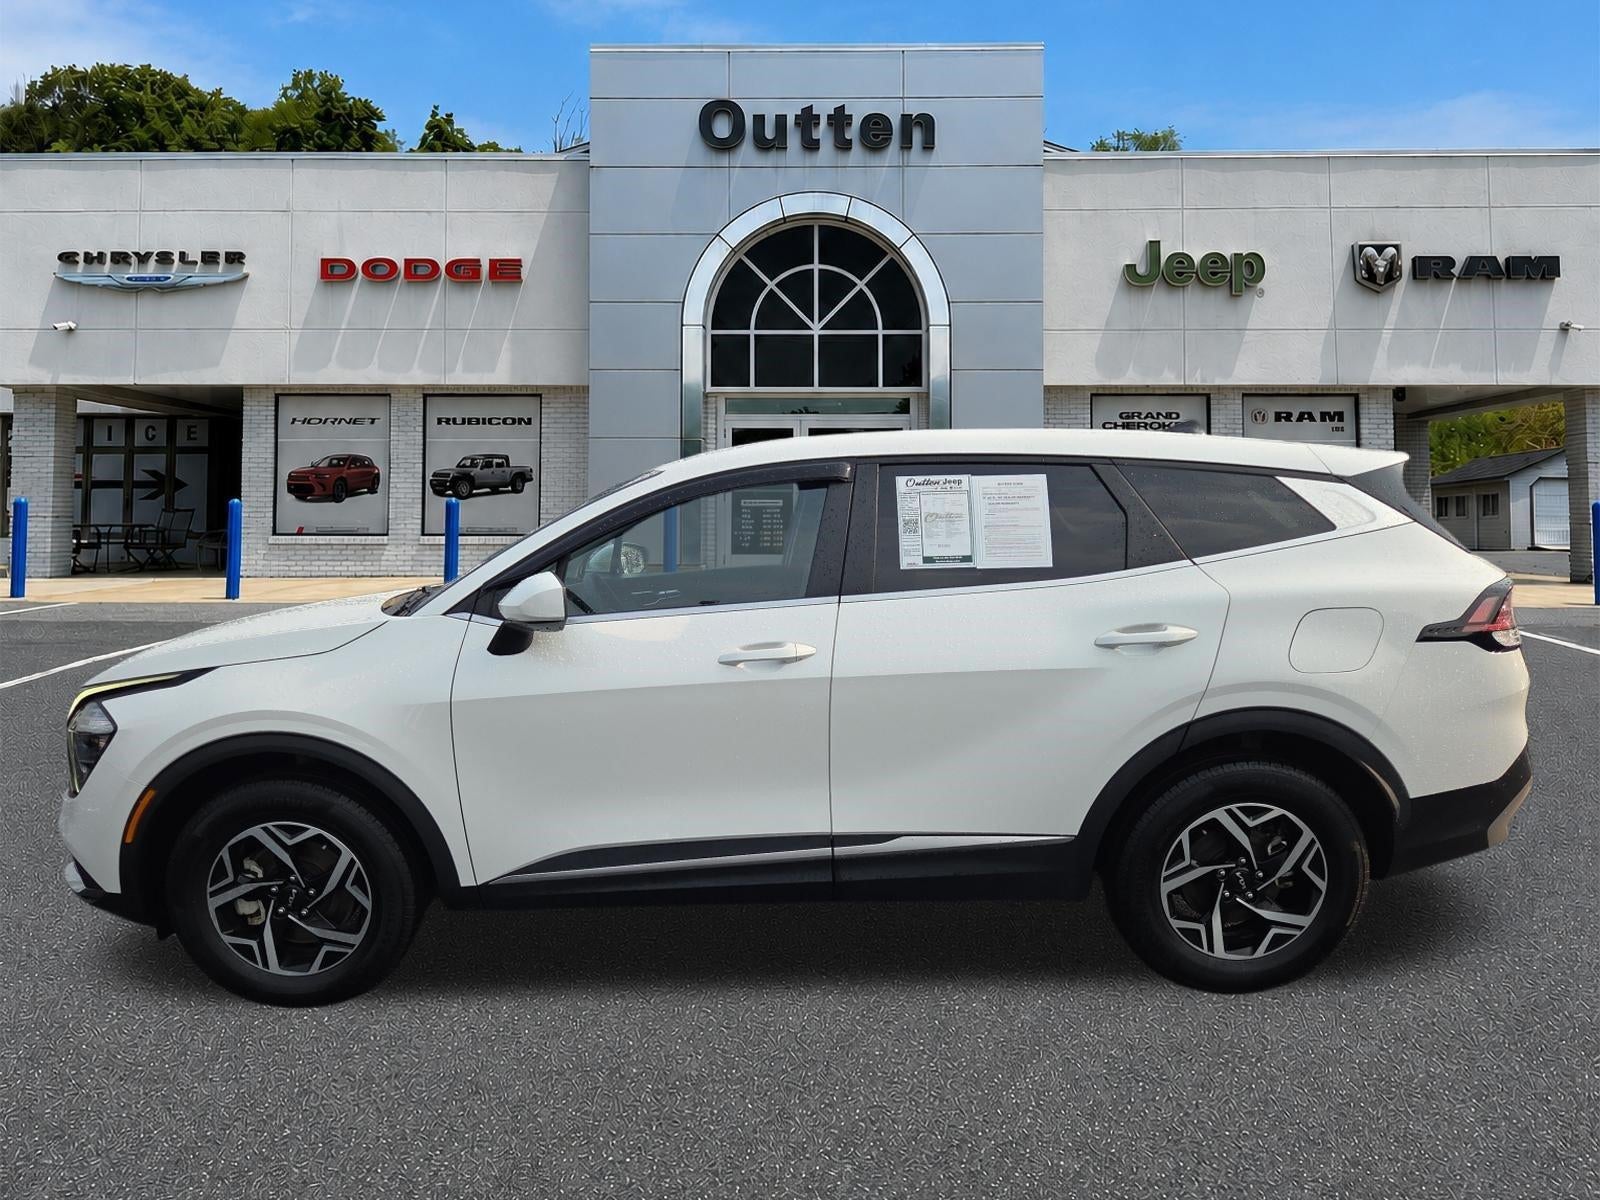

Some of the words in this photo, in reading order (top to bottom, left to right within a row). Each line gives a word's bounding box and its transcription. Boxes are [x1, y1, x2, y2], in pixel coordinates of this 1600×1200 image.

[699, 99, 935, 150] Outten
[57, 251, 246, 266] CHRYSLER
[320, 257, 523, 282] DODGE
[1123, 240, 1266, 296] Jeep
[1411, 255, 1561, 280] RAM
[290, 417, 380, 425] HORNET
[437, 416, 532, 426] RUBICON
[1118, 411, 1180, 420] GRAND
[1274, 411, 1345, 422] RAM
[1101, 421, 1176, 430] CHEROK
[943, 478, 963, 487] Jeep
